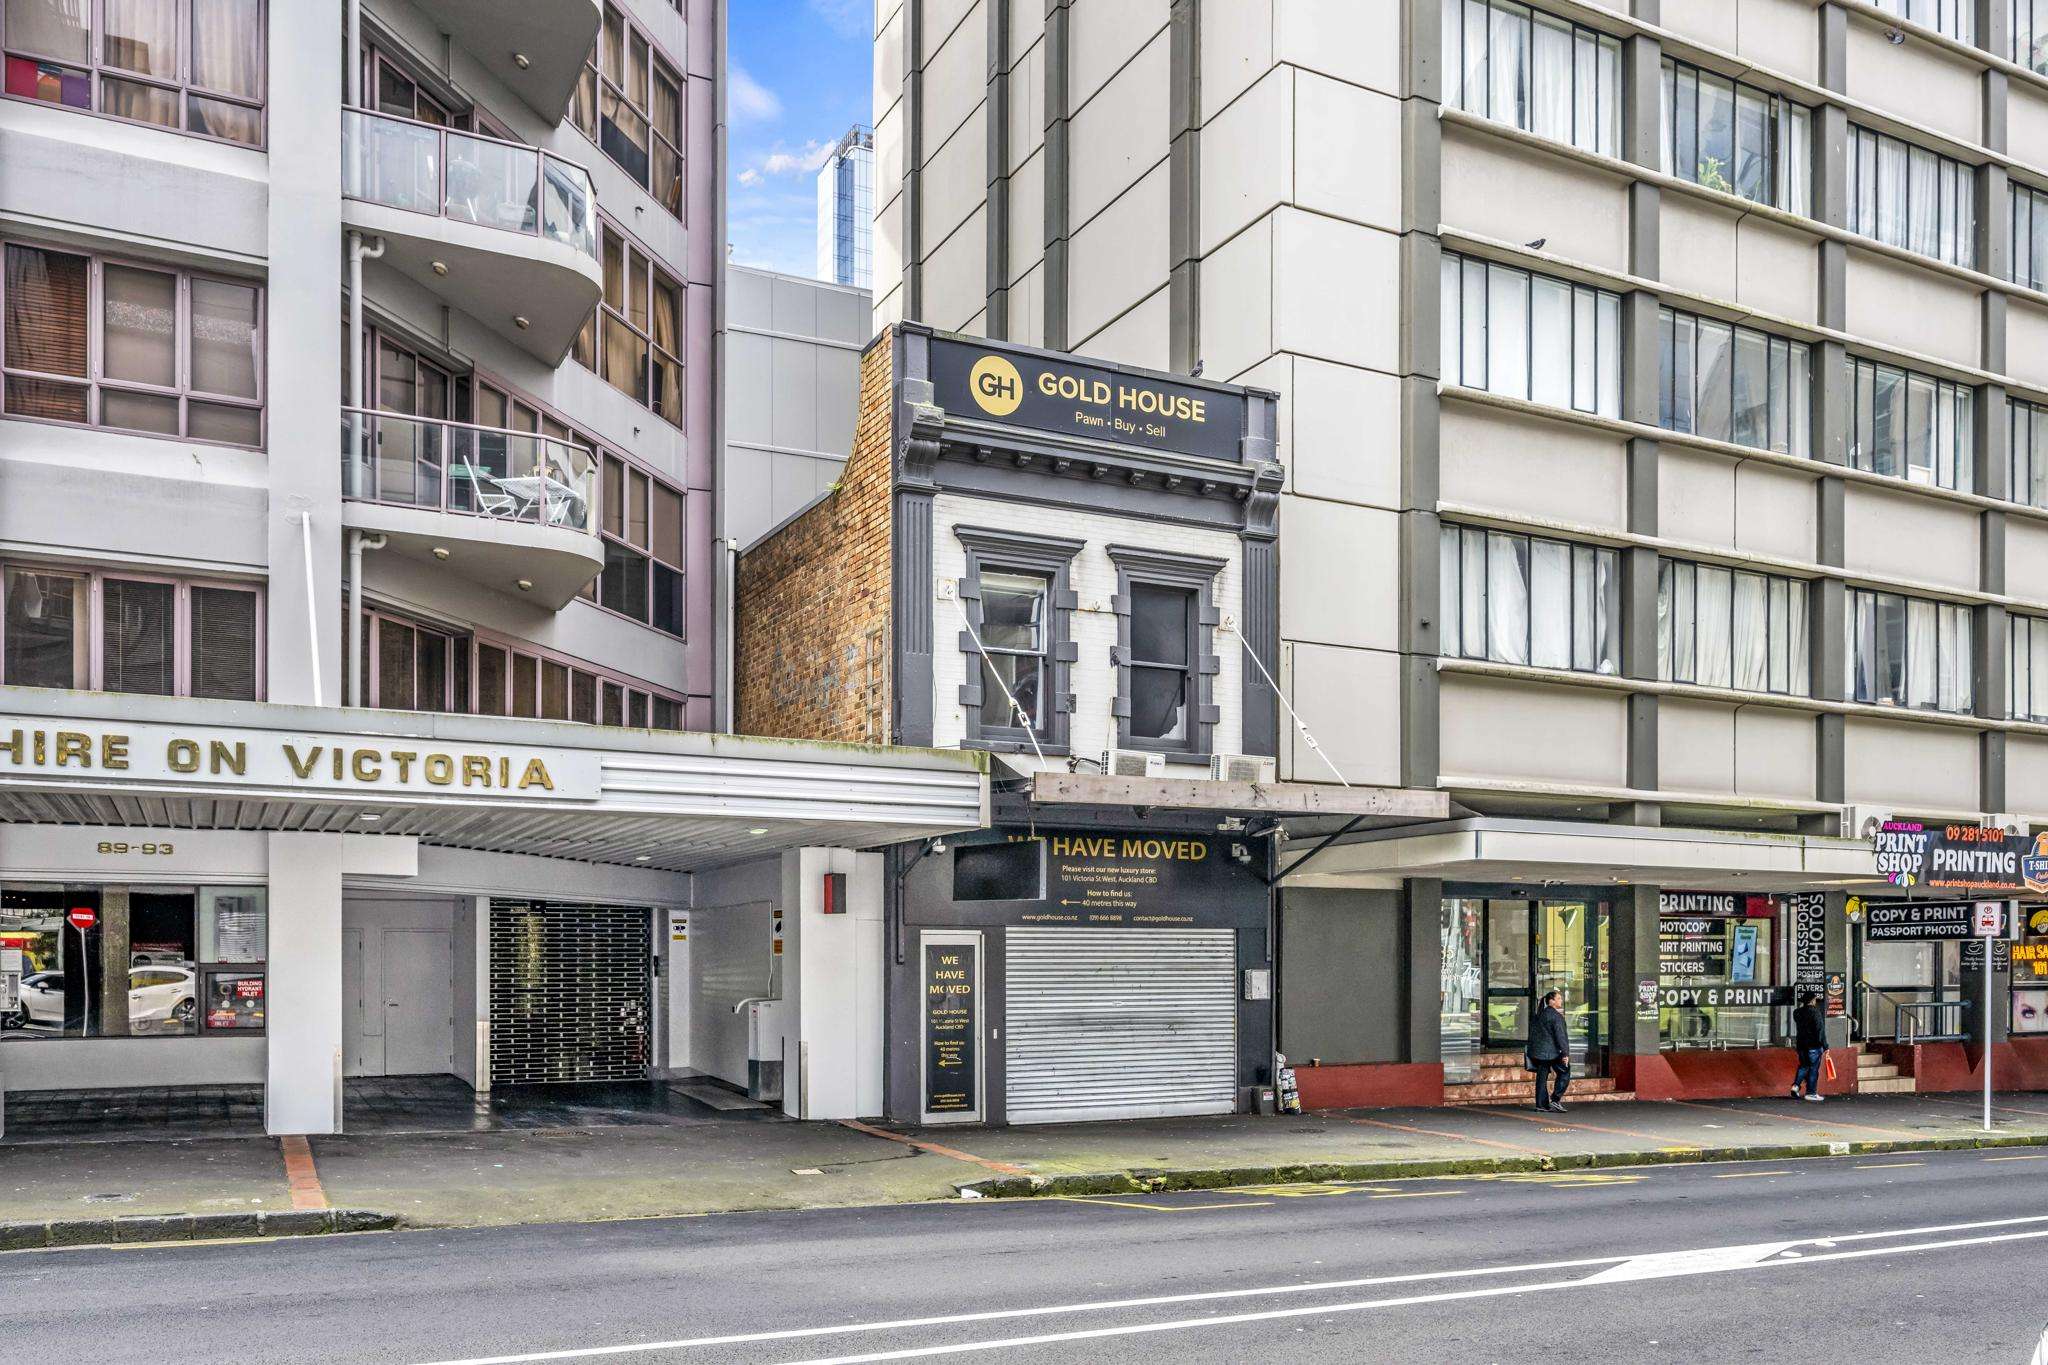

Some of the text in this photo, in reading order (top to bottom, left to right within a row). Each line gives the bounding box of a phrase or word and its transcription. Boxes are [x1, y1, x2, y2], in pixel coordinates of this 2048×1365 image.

[978, 372, 1014, 400] GH
[1038, 372, 1205, 422] GOLD HOUSE
[1075, 411, 1166, 437] Pawn Buy Sell
[167, 739, 246, 775] ON
[282, 744, 554, 790] VICTORIA
[1883, 821, 1922, 831] AUCKLAND
[1945, 825, 2004, 843] 09 281 5101
[97, 842, 174, 856] 89-93
[1053, 837, 1207, 860] HAVE MOVED
[1875, 832, 1928, 853] PRINT
[1877, 853, 1923, 873] SHOP
[1933, 848, 2016, 874] PRINTING
[1062, 864, 1081, 873] Please
[1083, 865, 1095, 873] visit
[1120, 866, 1139, 876] luxury
[1061, 874, 1072, 882] 101
[1145, 876, 1158, 884] CBD
[1929, 879, 2016, 889] www.printshopauckland.co.nz
[1087, 889, 1102, 897] How
[1110, 889, 1123, 897] find
[1081, 899, 1090, 907] 40
[1113, 900, 1124, 908] this
[1660, 894, 1734, 912] PRINTING
[1022, 914, 1078, 922] www.goldhouse.co.nz
[1870, 906, 1967, 922] COPY & PRINT
[1798, 895, 1809, 964] PASSPORT
[1809, 894, 1824, 965] PHOTOS
[1871, 924, 1968, 937] PASSPORT PHOTOS
[1680, 941, 1723, 953] PRINTING
[2013, 945, 2036, 960] HAIR
[941, 956, 959, 965] WE
[1660, 962, 1705, 973] STICKERS
[935, 970, 965, 979] HAVE
[1798, 970, 1824, 978] POSTER
[929, 985, 971, 994] MOVED
[1797, 984, 1824, 992] FLYERS
[1660, 988, 1774, 1006] COPY & PRINT
